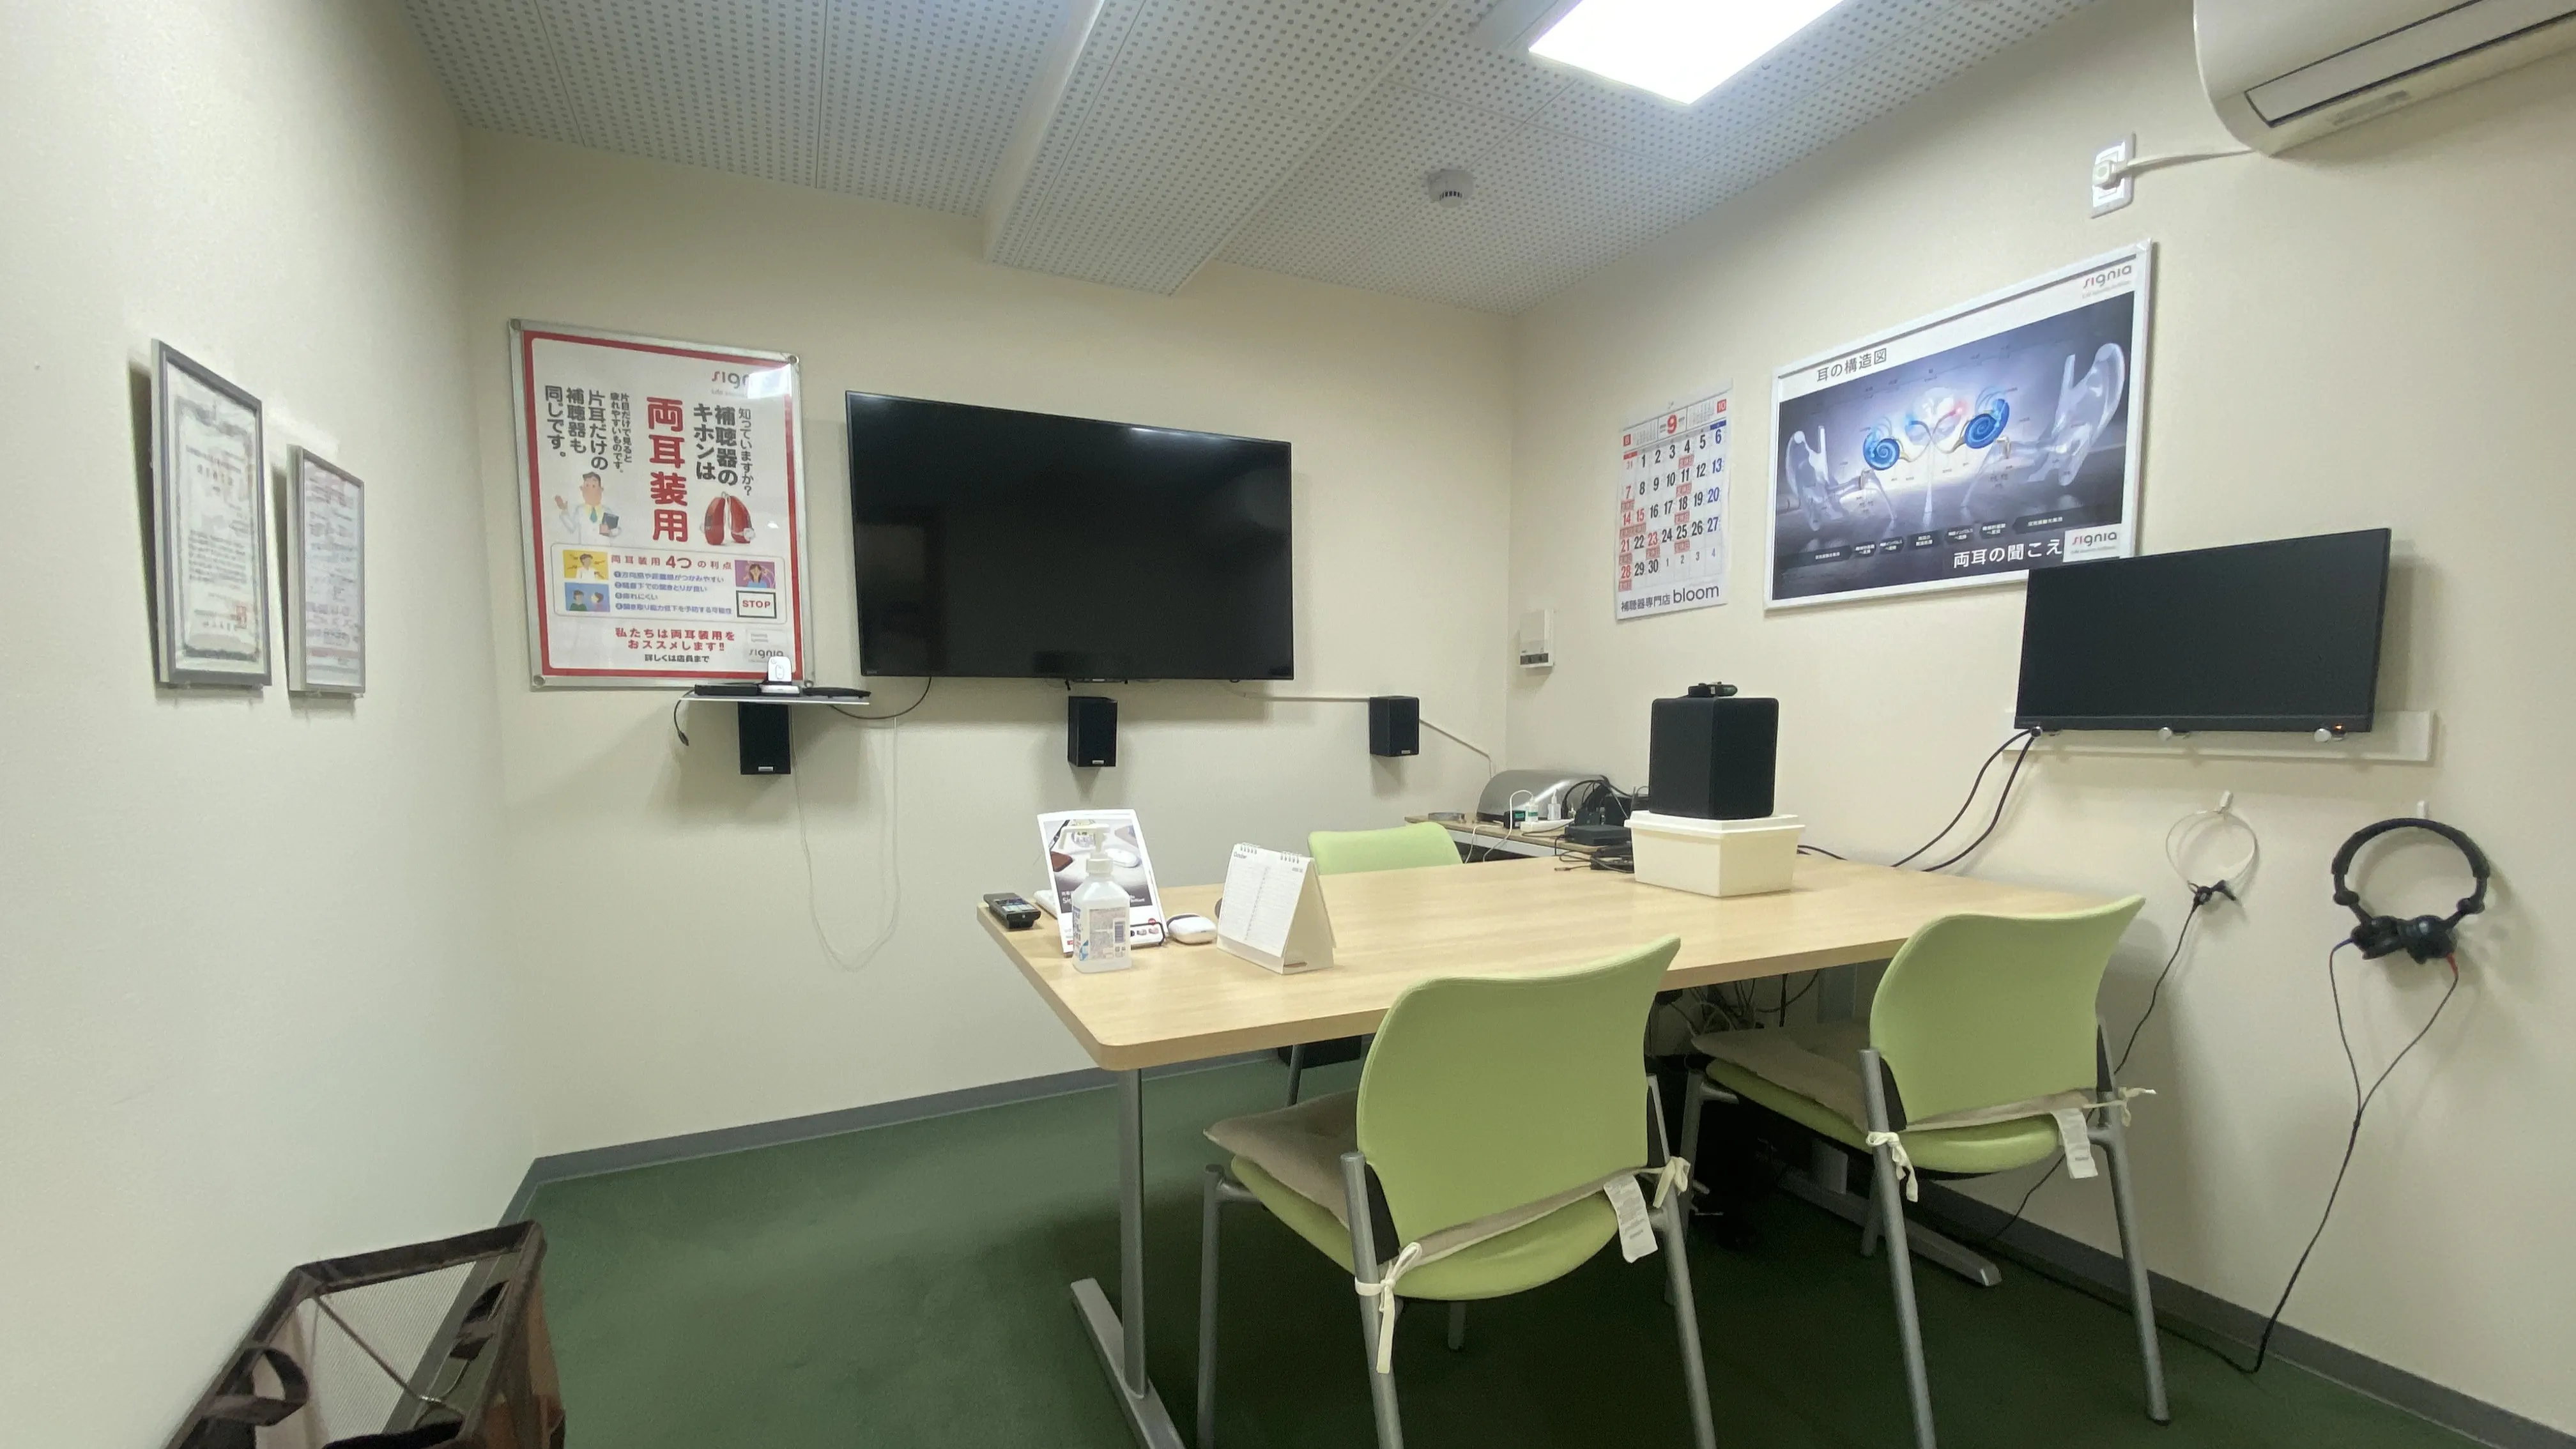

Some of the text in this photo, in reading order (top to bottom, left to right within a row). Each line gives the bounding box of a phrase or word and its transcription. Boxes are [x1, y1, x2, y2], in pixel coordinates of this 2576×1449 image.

[2083, 265, 2132, 289] signia
[1817, 348, 1887, 382] 耳の構造図
[545, 385, 566, 457] 同じです。
[566, 387, 586, 454] 補聴器も
[588, 389, 608, 470] 片耳だけの
[620, 393, 632, 463] 片目だけで見ると
[1667, 414, 1677, 434] 9
[693, 403, 716, 480] キホンは
[715, 405, 738, 486] 補聴器の
[1642, 454, 1646, 468] 1
[1655, 449, 1660, 464] 2
[1669, 445, 1675, 459] 3
[1684, 440, 1690, 454] 4
[1699, 434, 1706, 449] 5
[1715, 429, 1721, 444] 6
[647, 397, 688, 542] 両耳装用
[1626, 458, 1722, 499] 7 8 9 10 11 12 13
[1623, 512, 1630, 526] 14
[1637, 508, 1644, 522] 15
[1650, 504, 1659, 518] 16
[1664, 500, 1673, 514] 17
[1679, 496, 1687, 510] 18
[1694, 491, 1703, 507] 19
[1707, 487, 1719, 503] 20
[1621, 539, 1629, 553] 21
[1634, 535, 1644, 549] 22
[1648, 532, 1657, 546] 23
[1662, 528, 1672, 542] 24
[1676, 524, 1687, 539] 25
[1692, 520, 1703, 536] 26
[1707, 516, 1719, 532] 27
[2073, 532, 2117, 547] signia
[1621, 548, 1715, 579] 28 29 30 1 2 3 4
[1954, 539, 2063, 569] 両耳の聞こえ
[742, 600, 770, 609] STOP
[1673, 585, 1719, 604] bloom
[615, 627, 735, 641] 私たちは両耳装用を
[645, 654, 710, 663] 詳しくは店員まで
